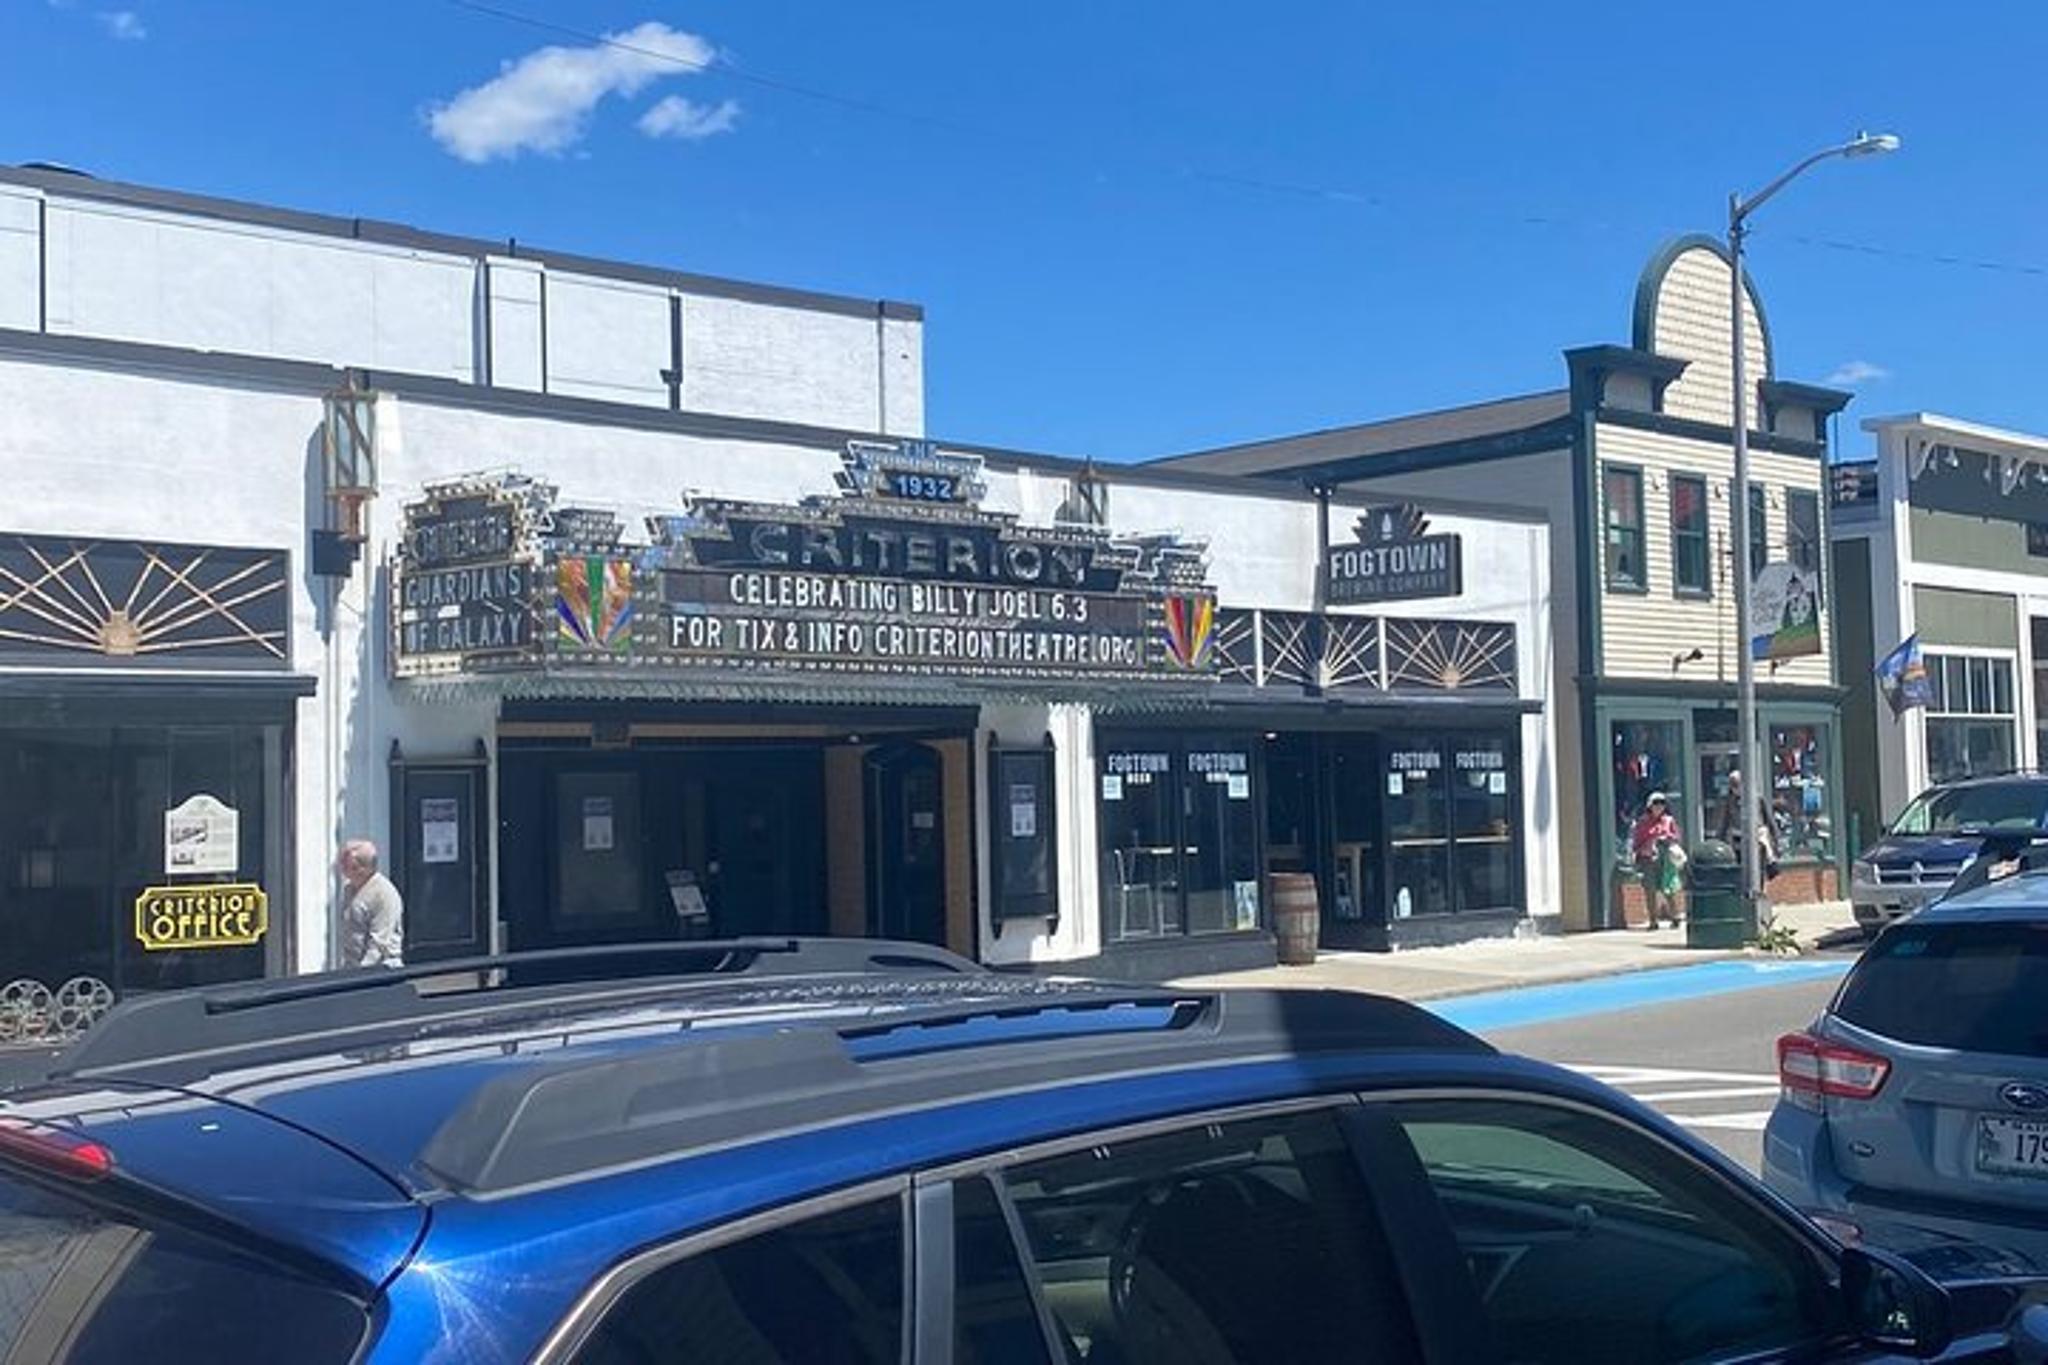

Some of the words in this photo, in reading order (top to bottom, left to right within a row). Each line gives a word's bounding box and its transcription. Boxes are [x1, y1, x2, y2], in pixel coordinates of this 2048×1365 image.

[898, 475, 952, 500] 1932
[750, 523, 1086, 584] CRITERION
[1329, 543, 1447, 579] FOGTOWN
[406, 566, 522, 606] GUARDIANS
[729, 573, 897, 613] CELEBRATING
[911, 584, 976, 616] BILLY
[989, 591, 1042, 620] JOEL
[1050, 593, 1088, 623] 6.3
[437, 612, 522, 649] GALAXY
[672, 615, 722, 647] FOR
[735, 619, 776, 650] TIX
[784, 621, 799, 650] &
[808, 621, 863, 653] INFO
[1108, 754, 1169, 772] FOGTOWN
[1188, 753, 1247, 772] FOGTOWN
[150, 895, 254, 916] CRITERION
[152, 913, 252, 941] OFFICE
